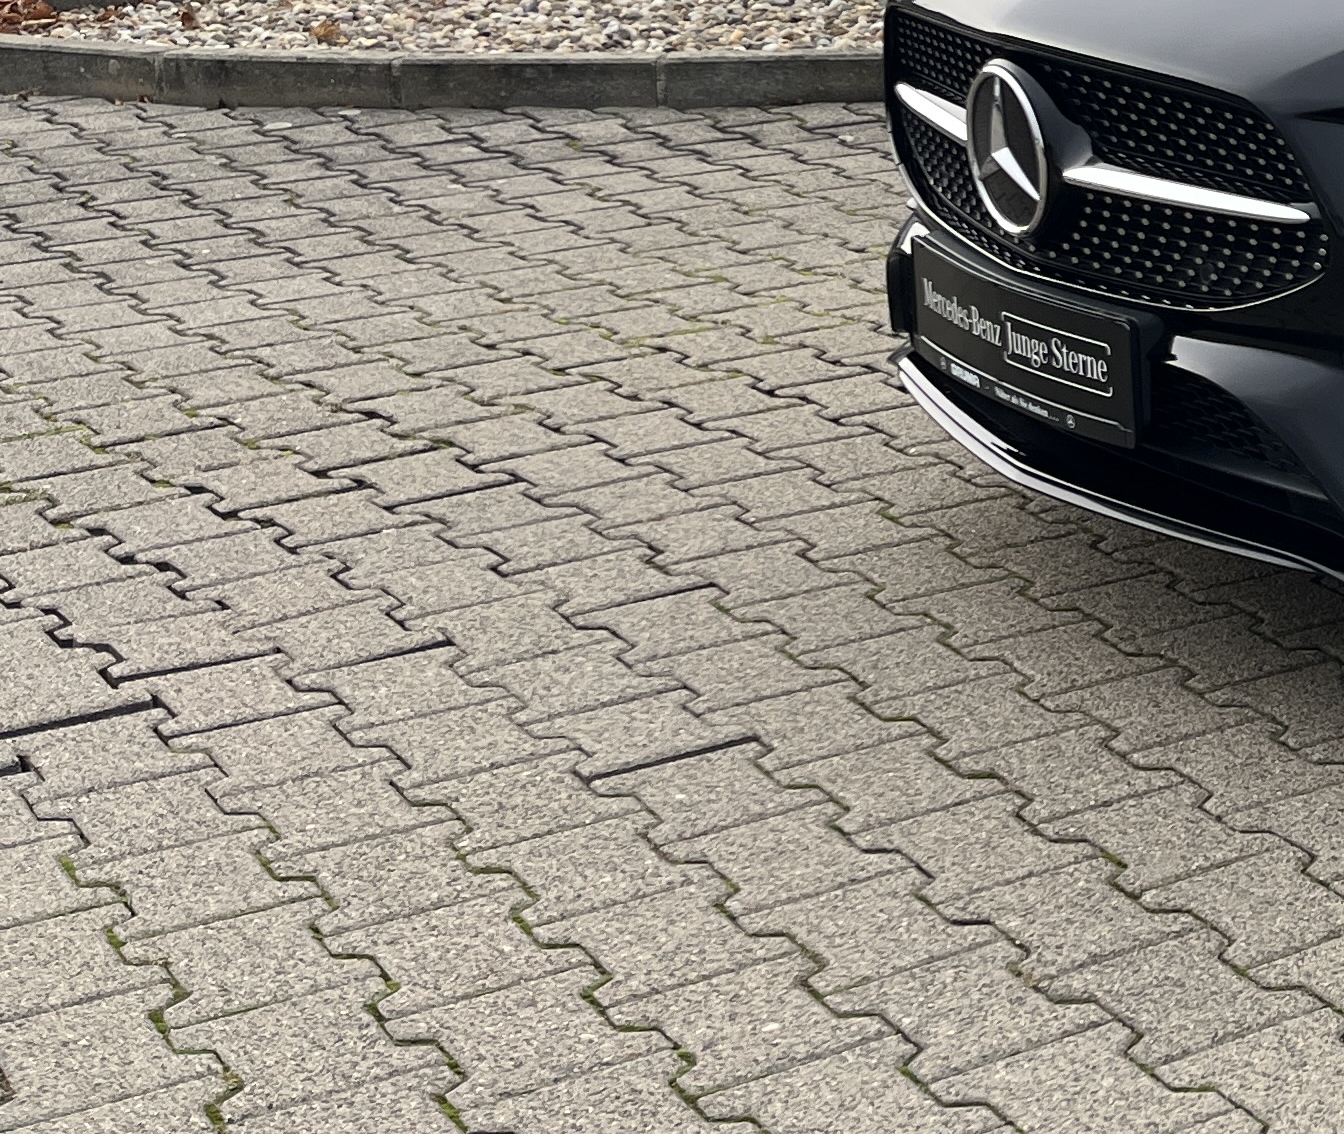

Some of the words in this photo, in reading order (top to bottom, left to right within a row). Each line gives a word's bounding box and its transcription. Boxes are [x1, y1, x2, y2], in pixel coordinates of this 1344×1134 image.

[922, 277, 1002, 347] Mercedes-Benz
[1005, 321, 1049, 368] Junge
[1050, 337, 1109, 383] Sterne
